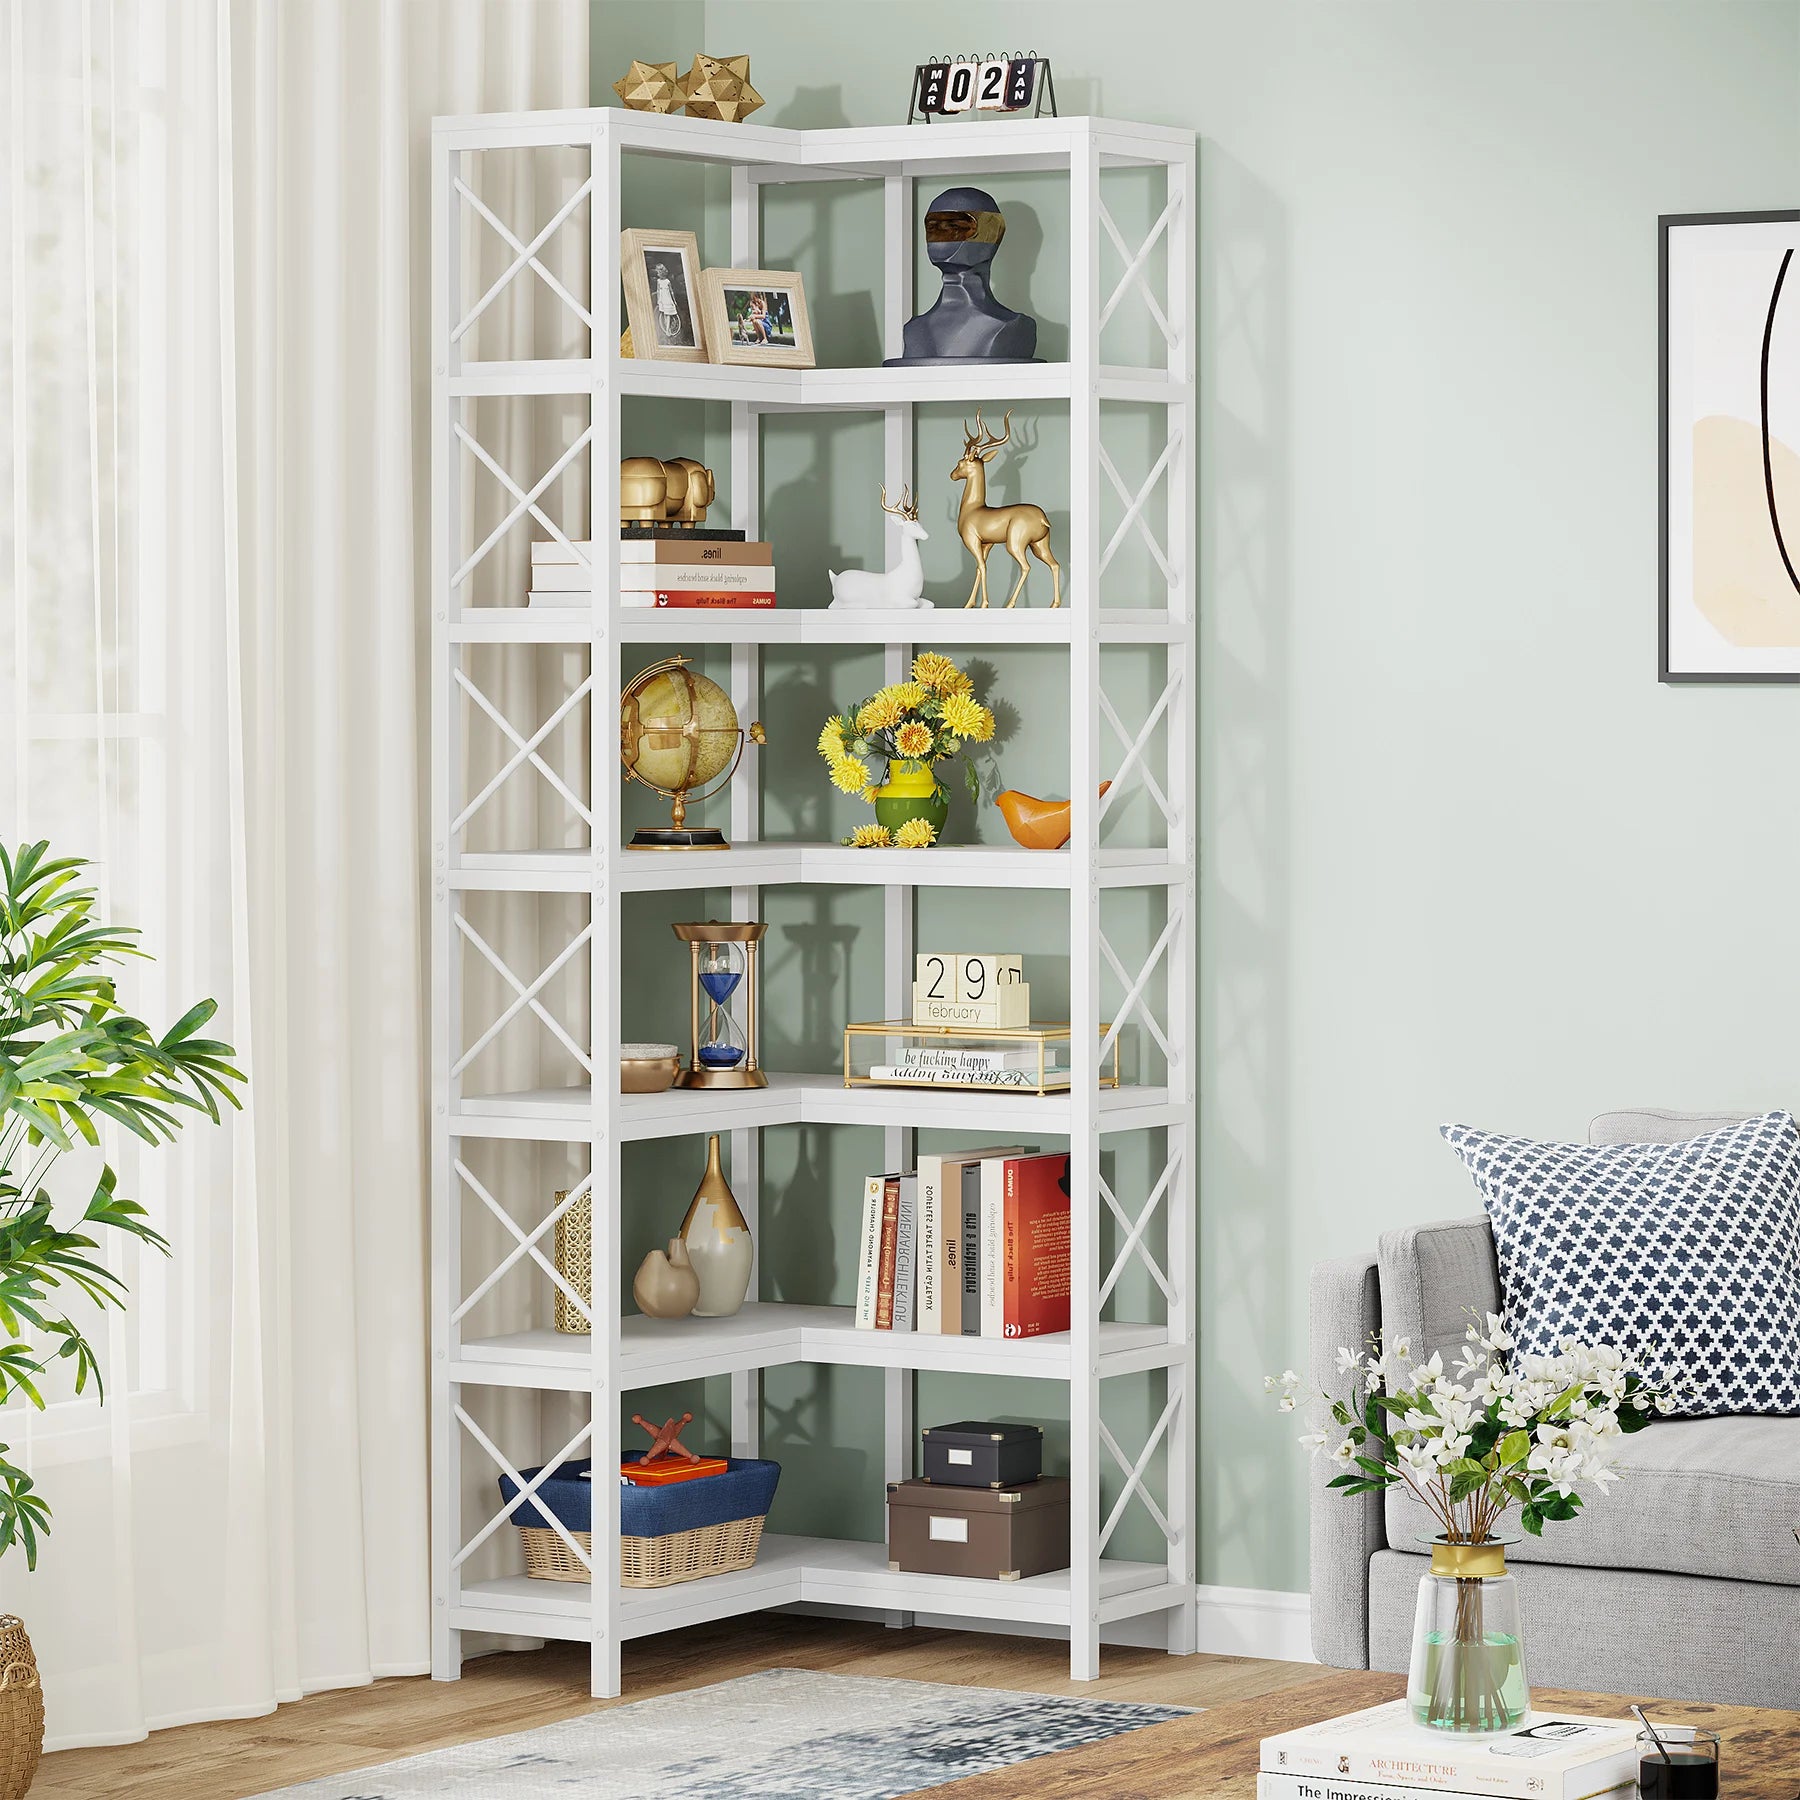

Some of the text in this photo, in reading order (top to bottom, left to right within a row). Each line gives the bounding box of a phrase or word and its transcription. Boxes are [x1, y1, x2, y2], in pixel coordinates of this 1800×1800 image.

[926, 69, 943, 105] MAR
[1014, 64, 1026, 100] JAN
[928, 1003, 981, 1023] february
[904, 1049, 990, 1071] be fucking happy
[890, 1067, 936, 1082] happy
[1368, 1759, 1458, 1777] ARCHITECTURE
[1297, 1785, 1322, 1799] The
